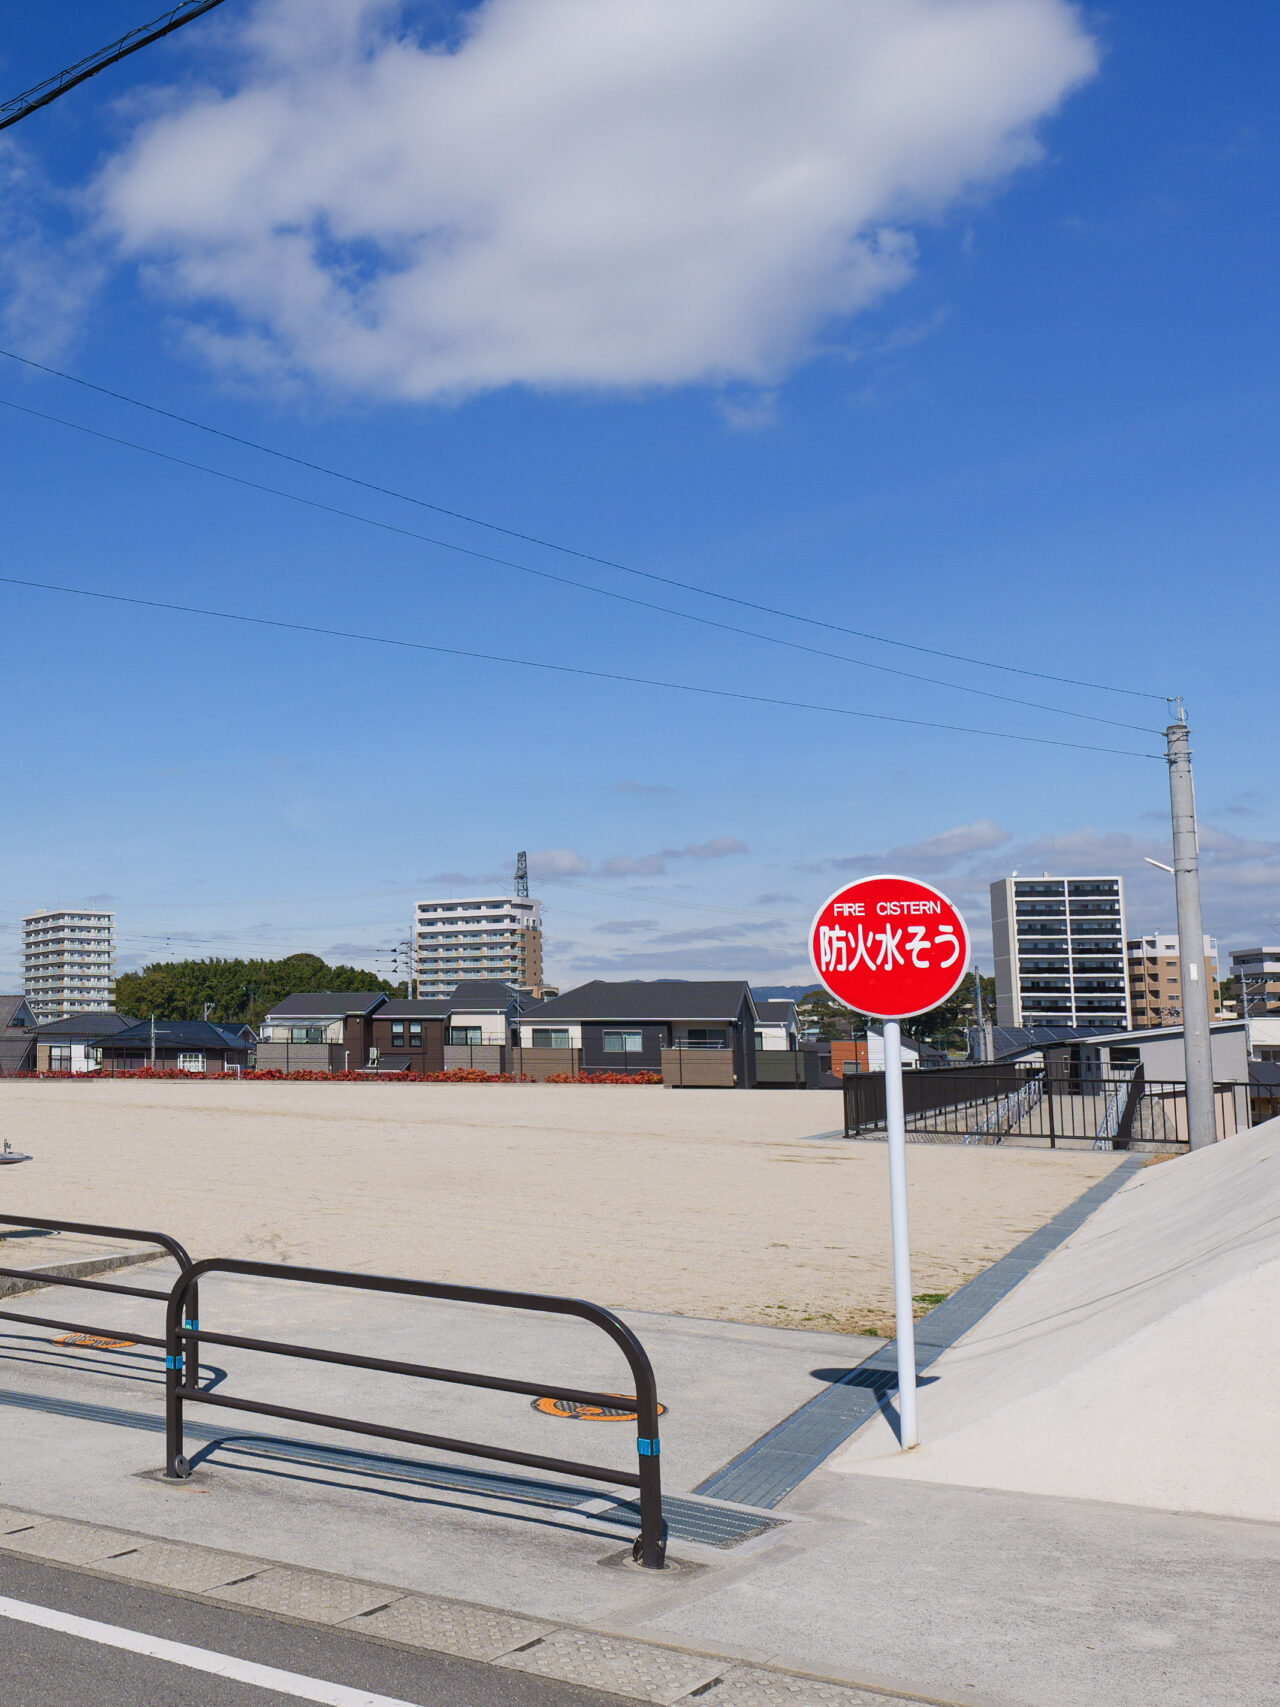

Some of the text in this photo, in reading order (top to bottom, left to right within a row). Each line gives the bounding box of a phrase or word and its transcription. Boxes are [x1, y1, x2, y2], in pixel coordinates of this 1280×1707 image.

[833, 900, 941, 917] FIRE CISTERN
[819, 922, 960, 972] 防火水そう
